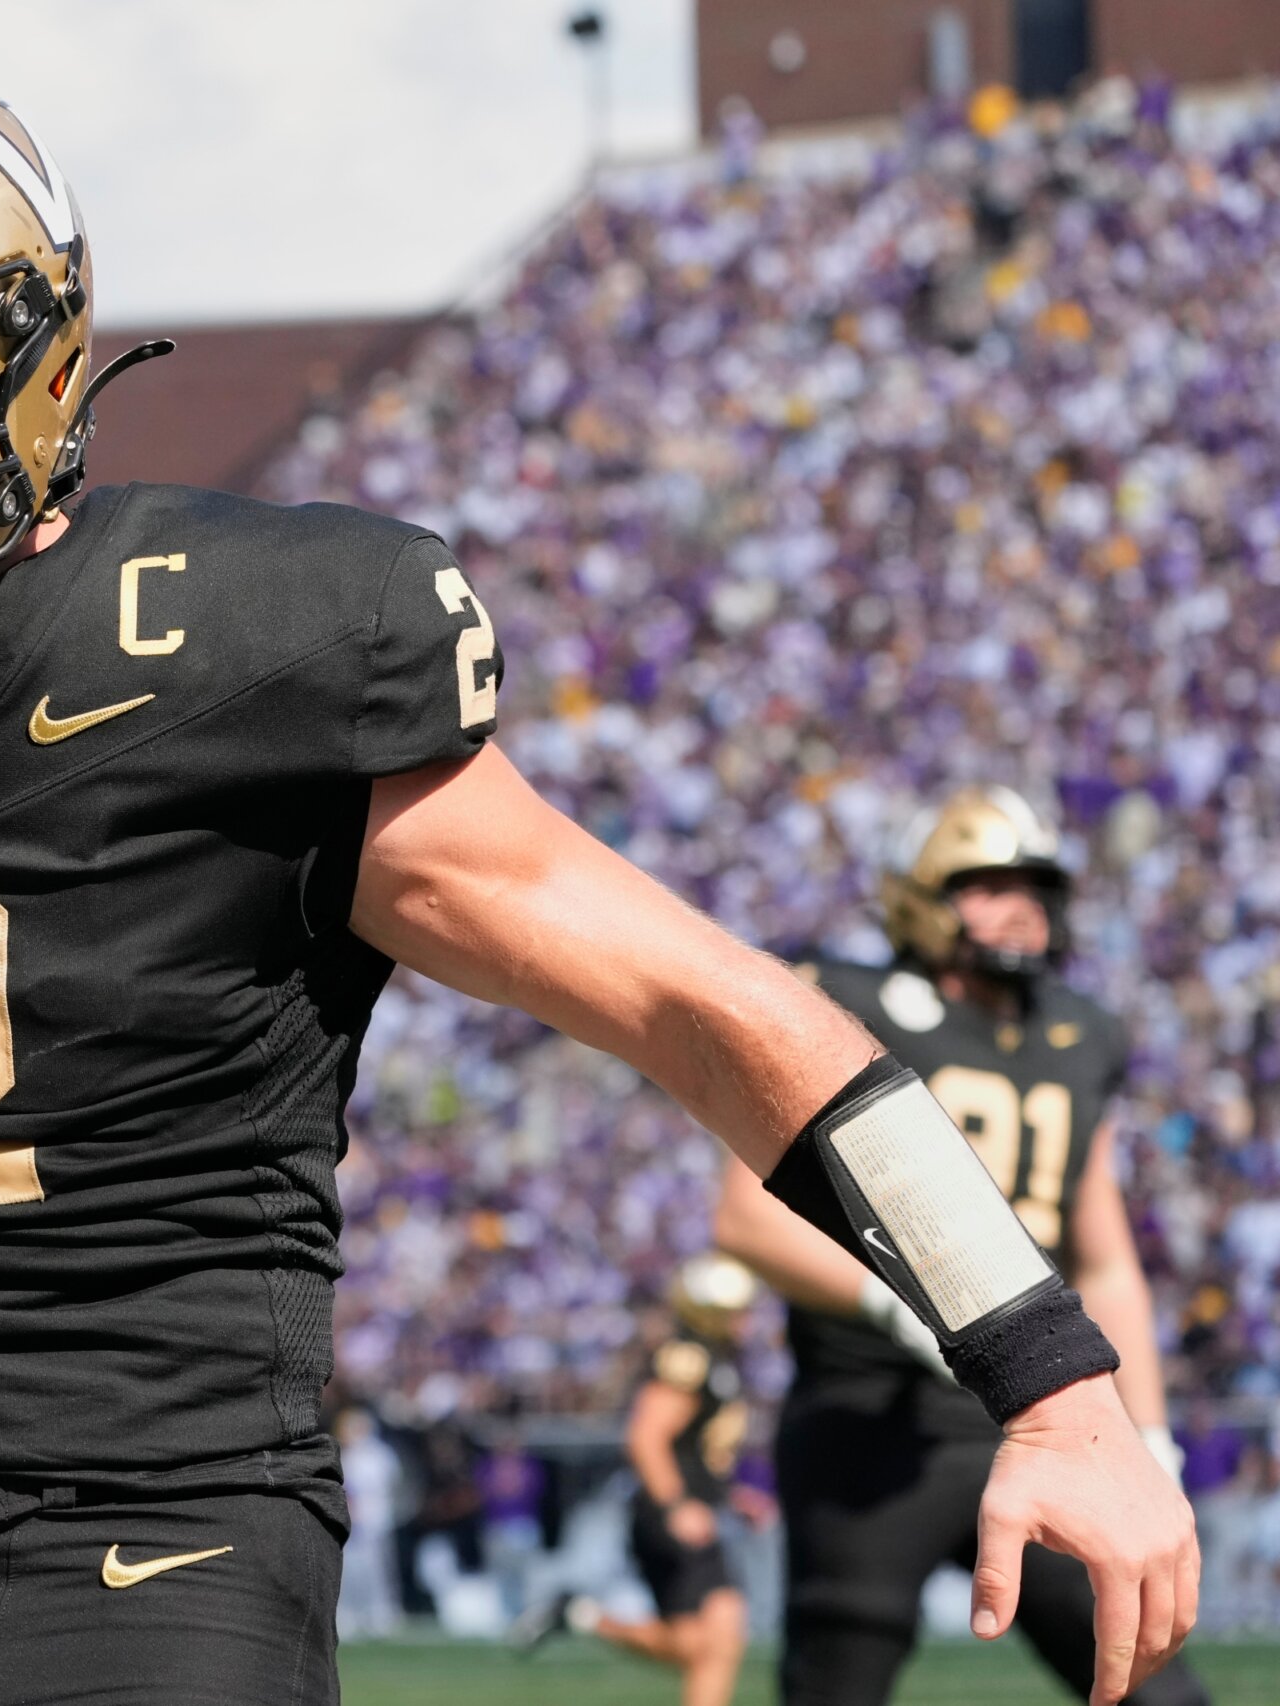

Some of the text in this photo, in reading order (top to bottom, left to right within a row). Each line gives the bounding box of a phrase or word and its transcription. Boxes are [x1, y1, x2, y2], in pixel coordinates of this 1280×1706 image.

[119, 552, 187, 656] C
[434, 567, 496, 730] 2
[924, 1065, 1073, 1249] 91
